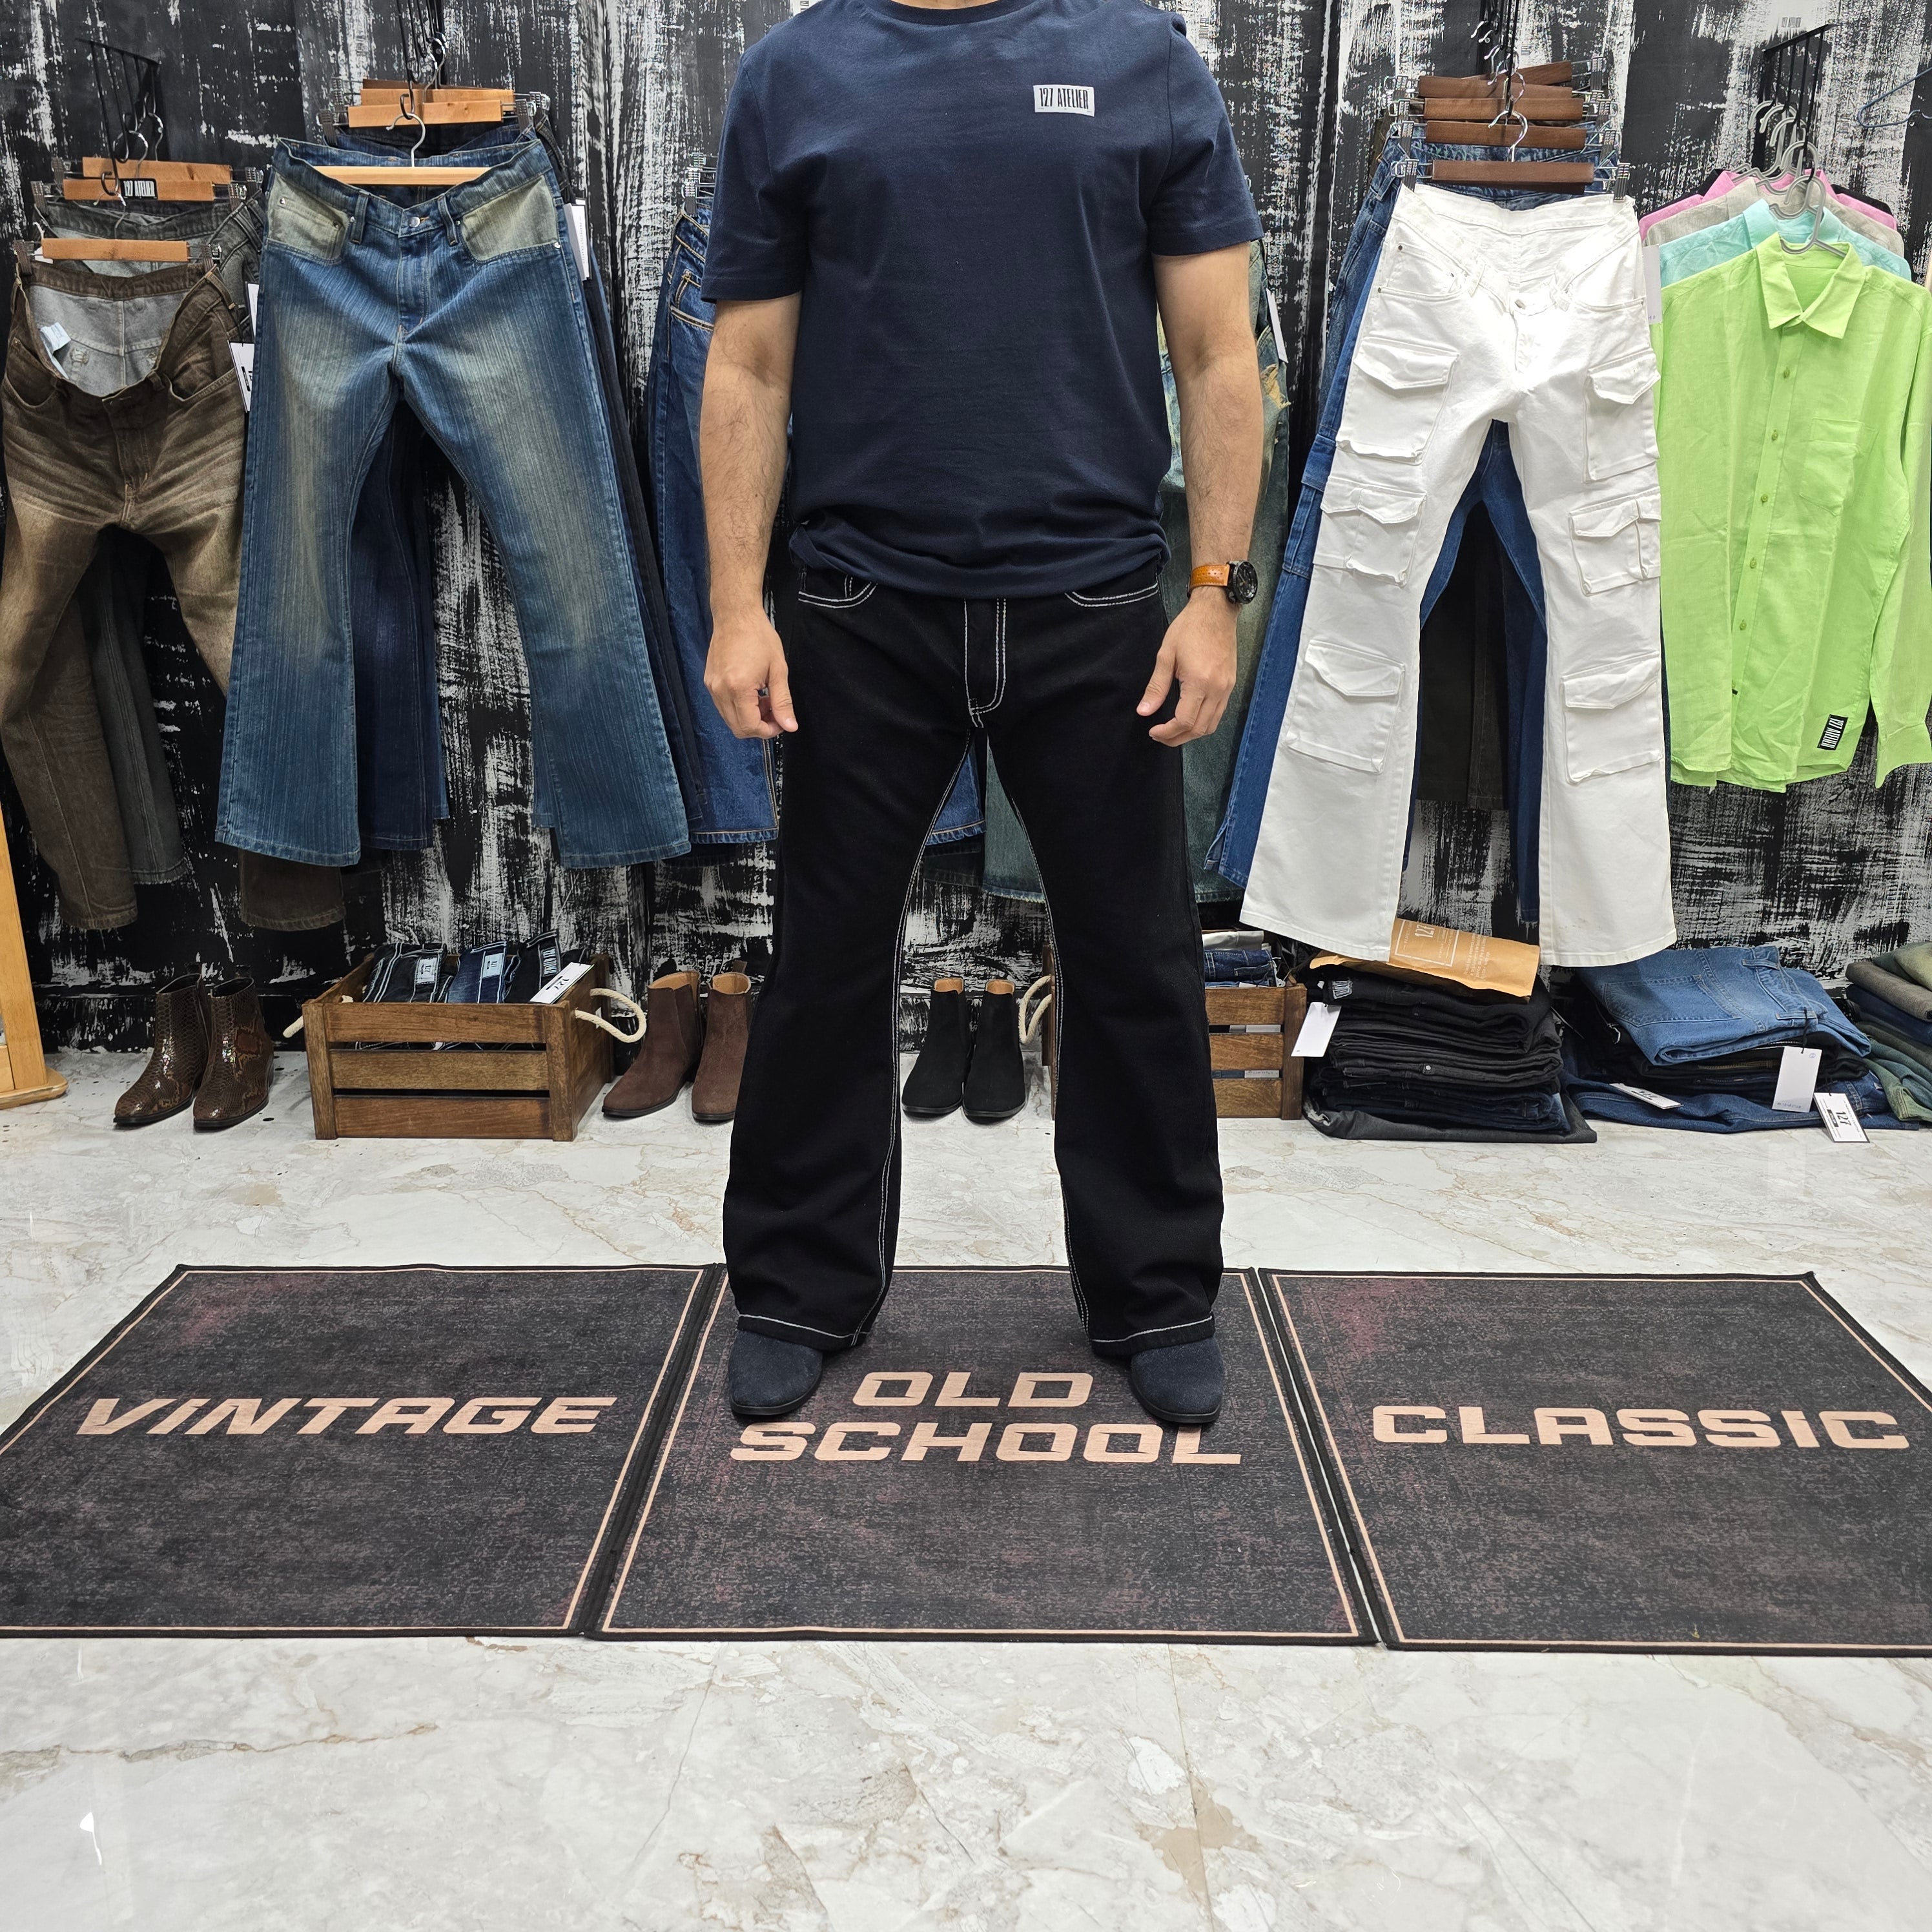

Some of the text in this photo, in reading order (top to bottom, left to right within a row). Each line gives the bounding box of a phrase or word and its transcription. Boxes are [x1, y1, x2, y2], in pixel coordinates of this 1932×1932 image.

[1039, 87, 1089, 110] 127 ATELIER
[1821, 717, 1844, 748] 127 ATELIER
[1414, 923, 1435, 938] 127
[1835, 1111, 1852, 1126] 127
[852, 1372, 1093, 1407] OLD
[77, 1397, 617, 1435] VINTAGE
[1373, 1405, 1909, 1449] CLASSIC
[730, 1422, 1242, 1464] SCHOOL
